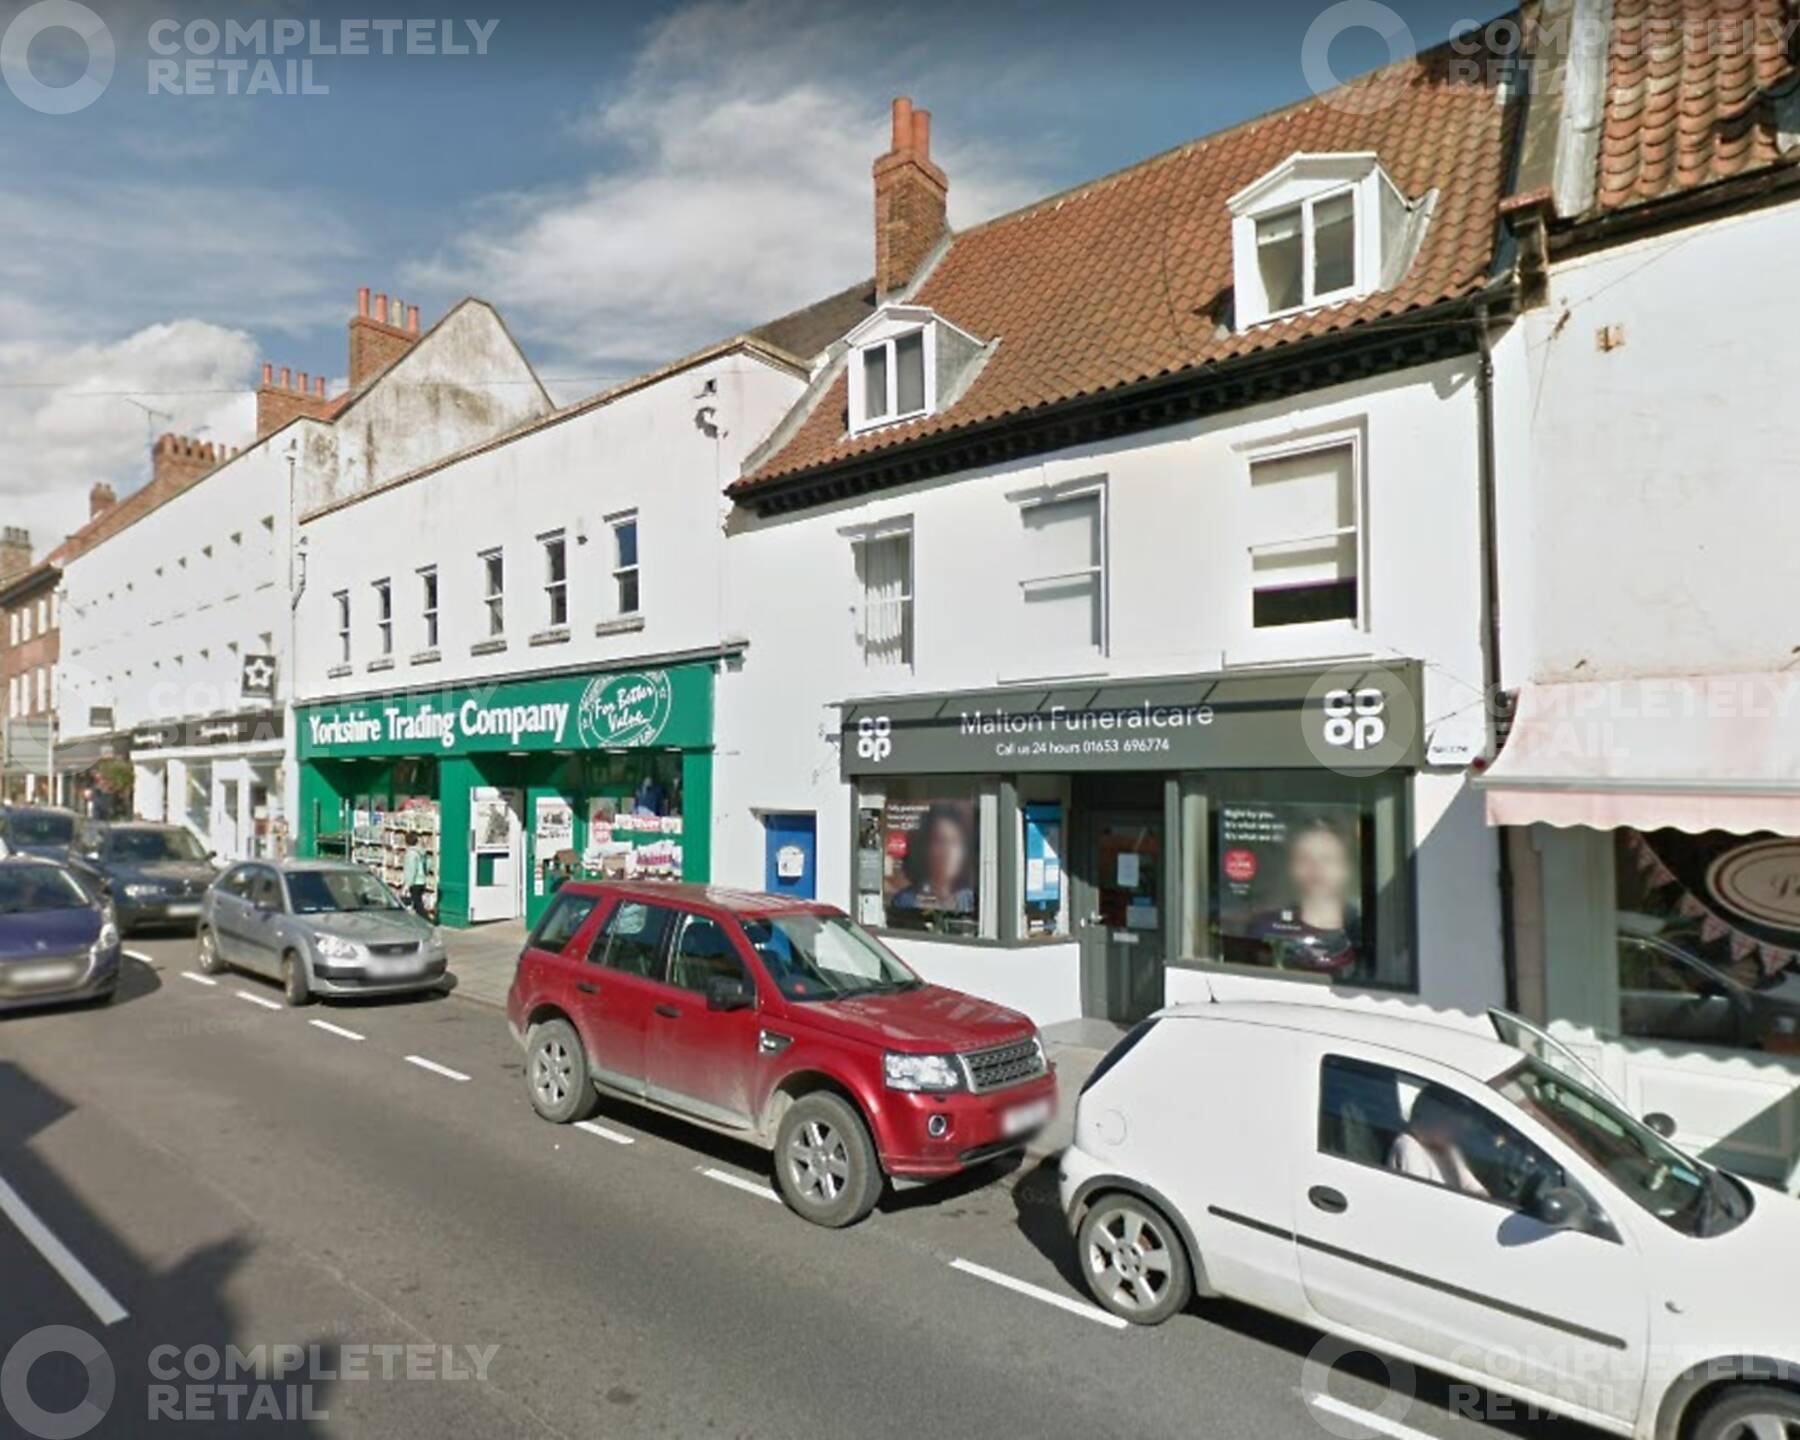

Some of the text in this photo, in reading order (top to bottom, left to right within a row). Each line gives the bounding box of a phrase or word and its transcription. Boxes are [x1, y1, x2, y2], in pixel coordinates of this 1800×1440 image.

[594, 698, 616, 719] For
[617, 685, 654, 710] Better
[960, 700, 1214, 735] Malton Funeralcare
[309, 699, 569, 748] Yorkshire Trading Company
[608, 707, 650, 734] Value
[996, 737, 1170, 756] Call us 24 hours 01653 696774
